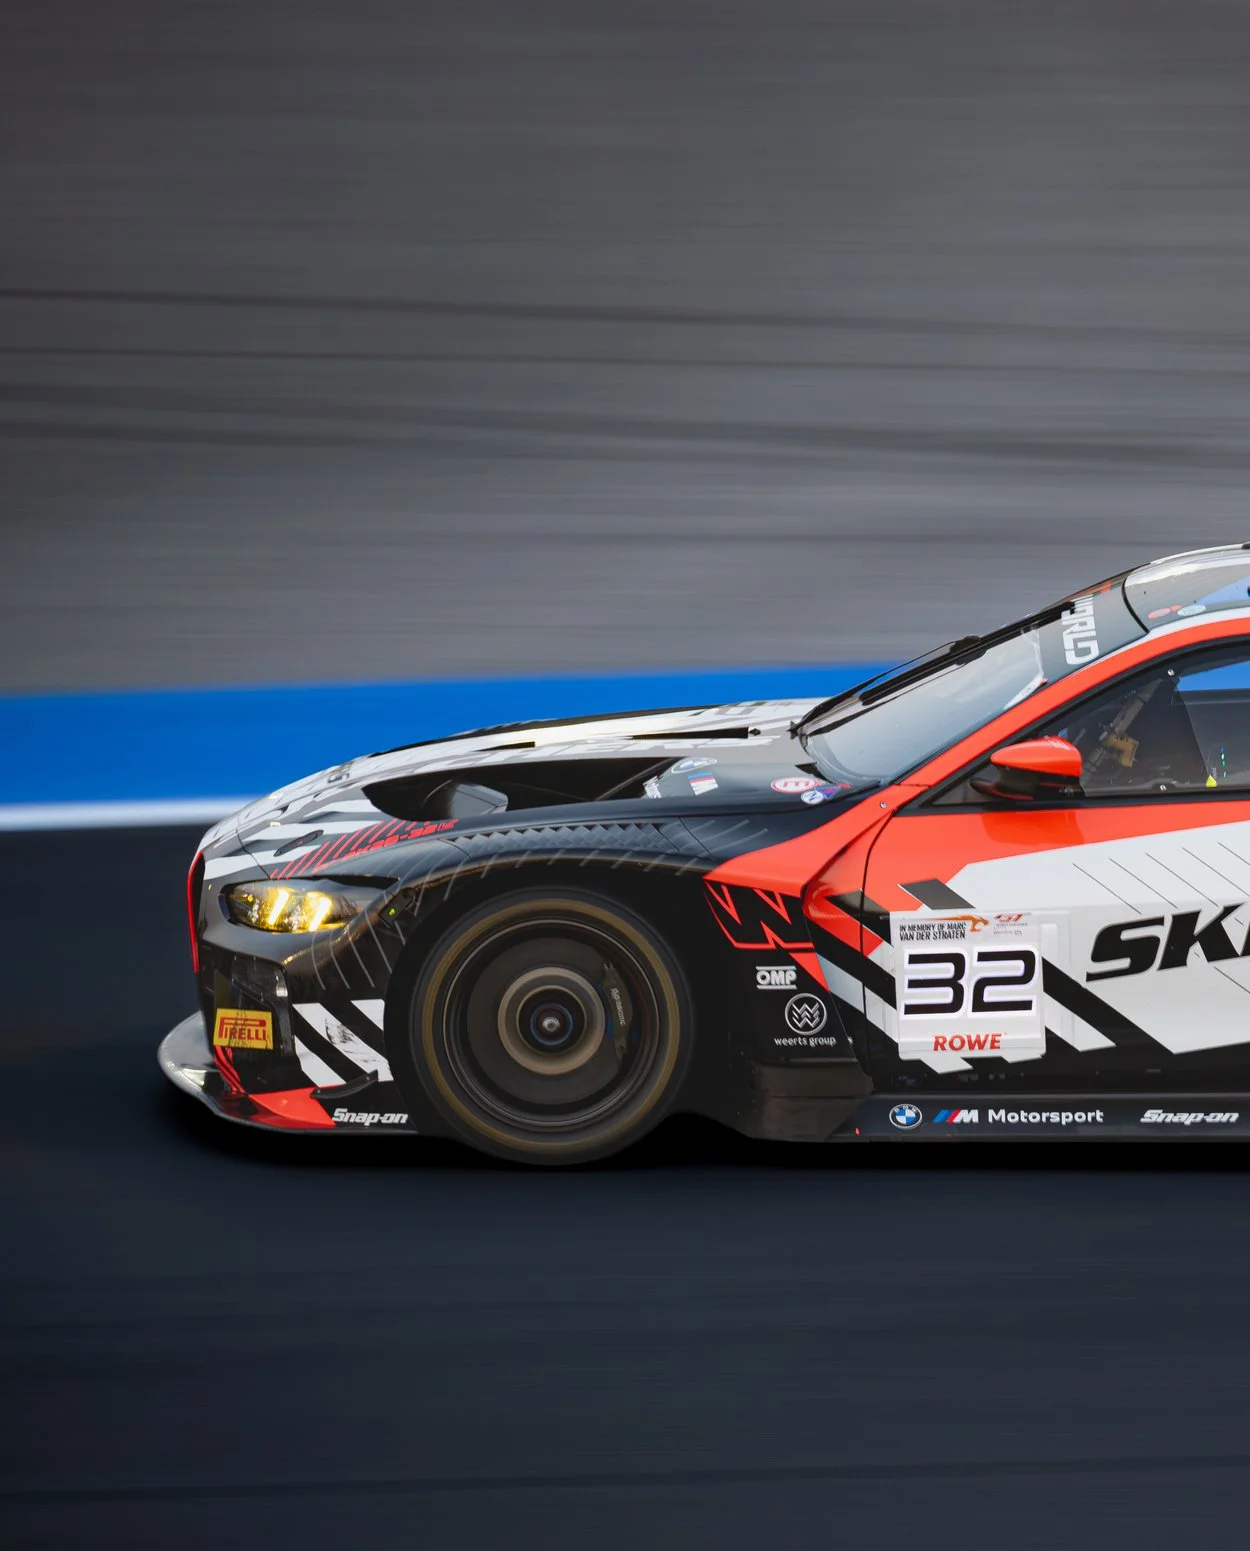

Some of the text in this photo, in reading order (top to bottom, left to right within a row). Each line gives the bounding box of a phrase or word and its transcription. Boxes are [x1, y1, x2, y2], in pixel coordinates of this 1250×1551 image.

[899, 922, 967, 932] IN MEMORY OF MARC
[900, 930, 966, 941] VAN DER STRATEN
[756, 970, 797, 986] OMP
[904, 949, 1036, 1015] 32
[218, 1016, 267, 1041] PIRELLI
[774, 1036, 837, 1047] weerts group
[933, 1033, 1002, 1052] ROWE
[332, 1108, 409, 1126] Snap-on
[988, 1108, 1104, 1125] Motorsport
[1139, 1108, 1240, 1126] Snap-on
